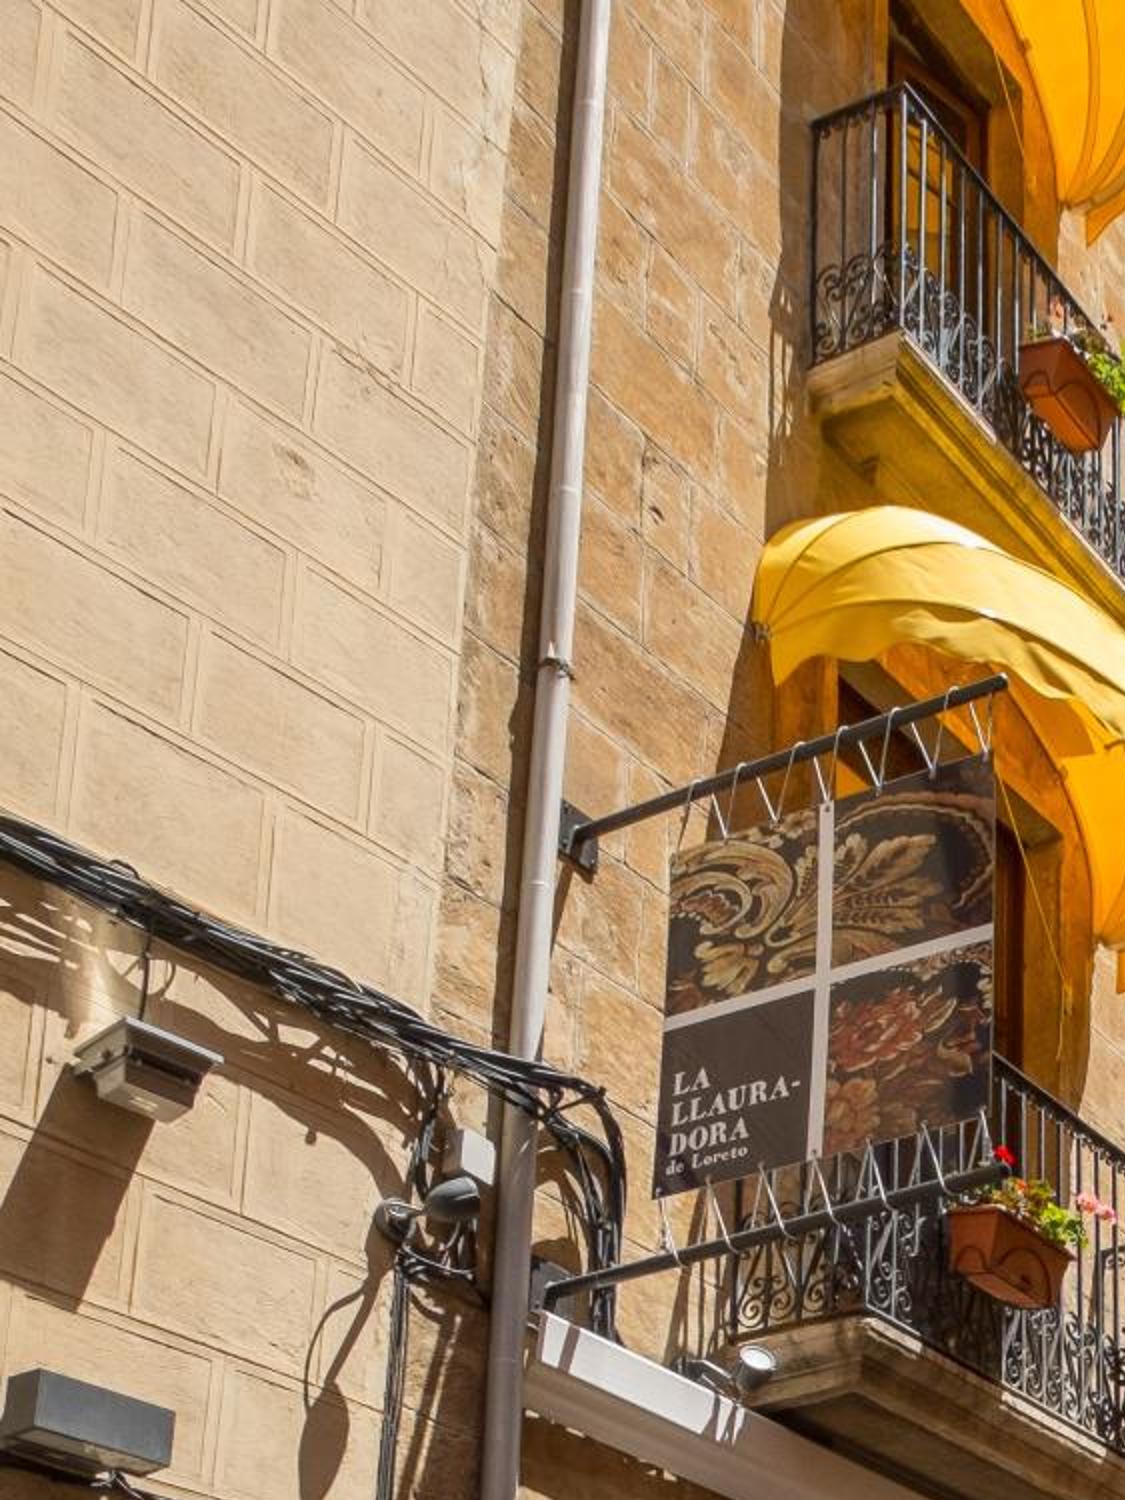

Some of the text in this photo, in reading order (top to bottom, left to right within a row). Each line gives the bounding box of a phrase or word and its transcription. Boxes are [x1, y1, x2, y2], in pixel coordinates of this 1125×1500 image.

[672, 1066, 711, 1096] LA
[671, 1075, 800, 1127] LLAURA-
[668, 1116, 749, 1157] DORA
[665, 1146, 749, 1175] de Loreto
